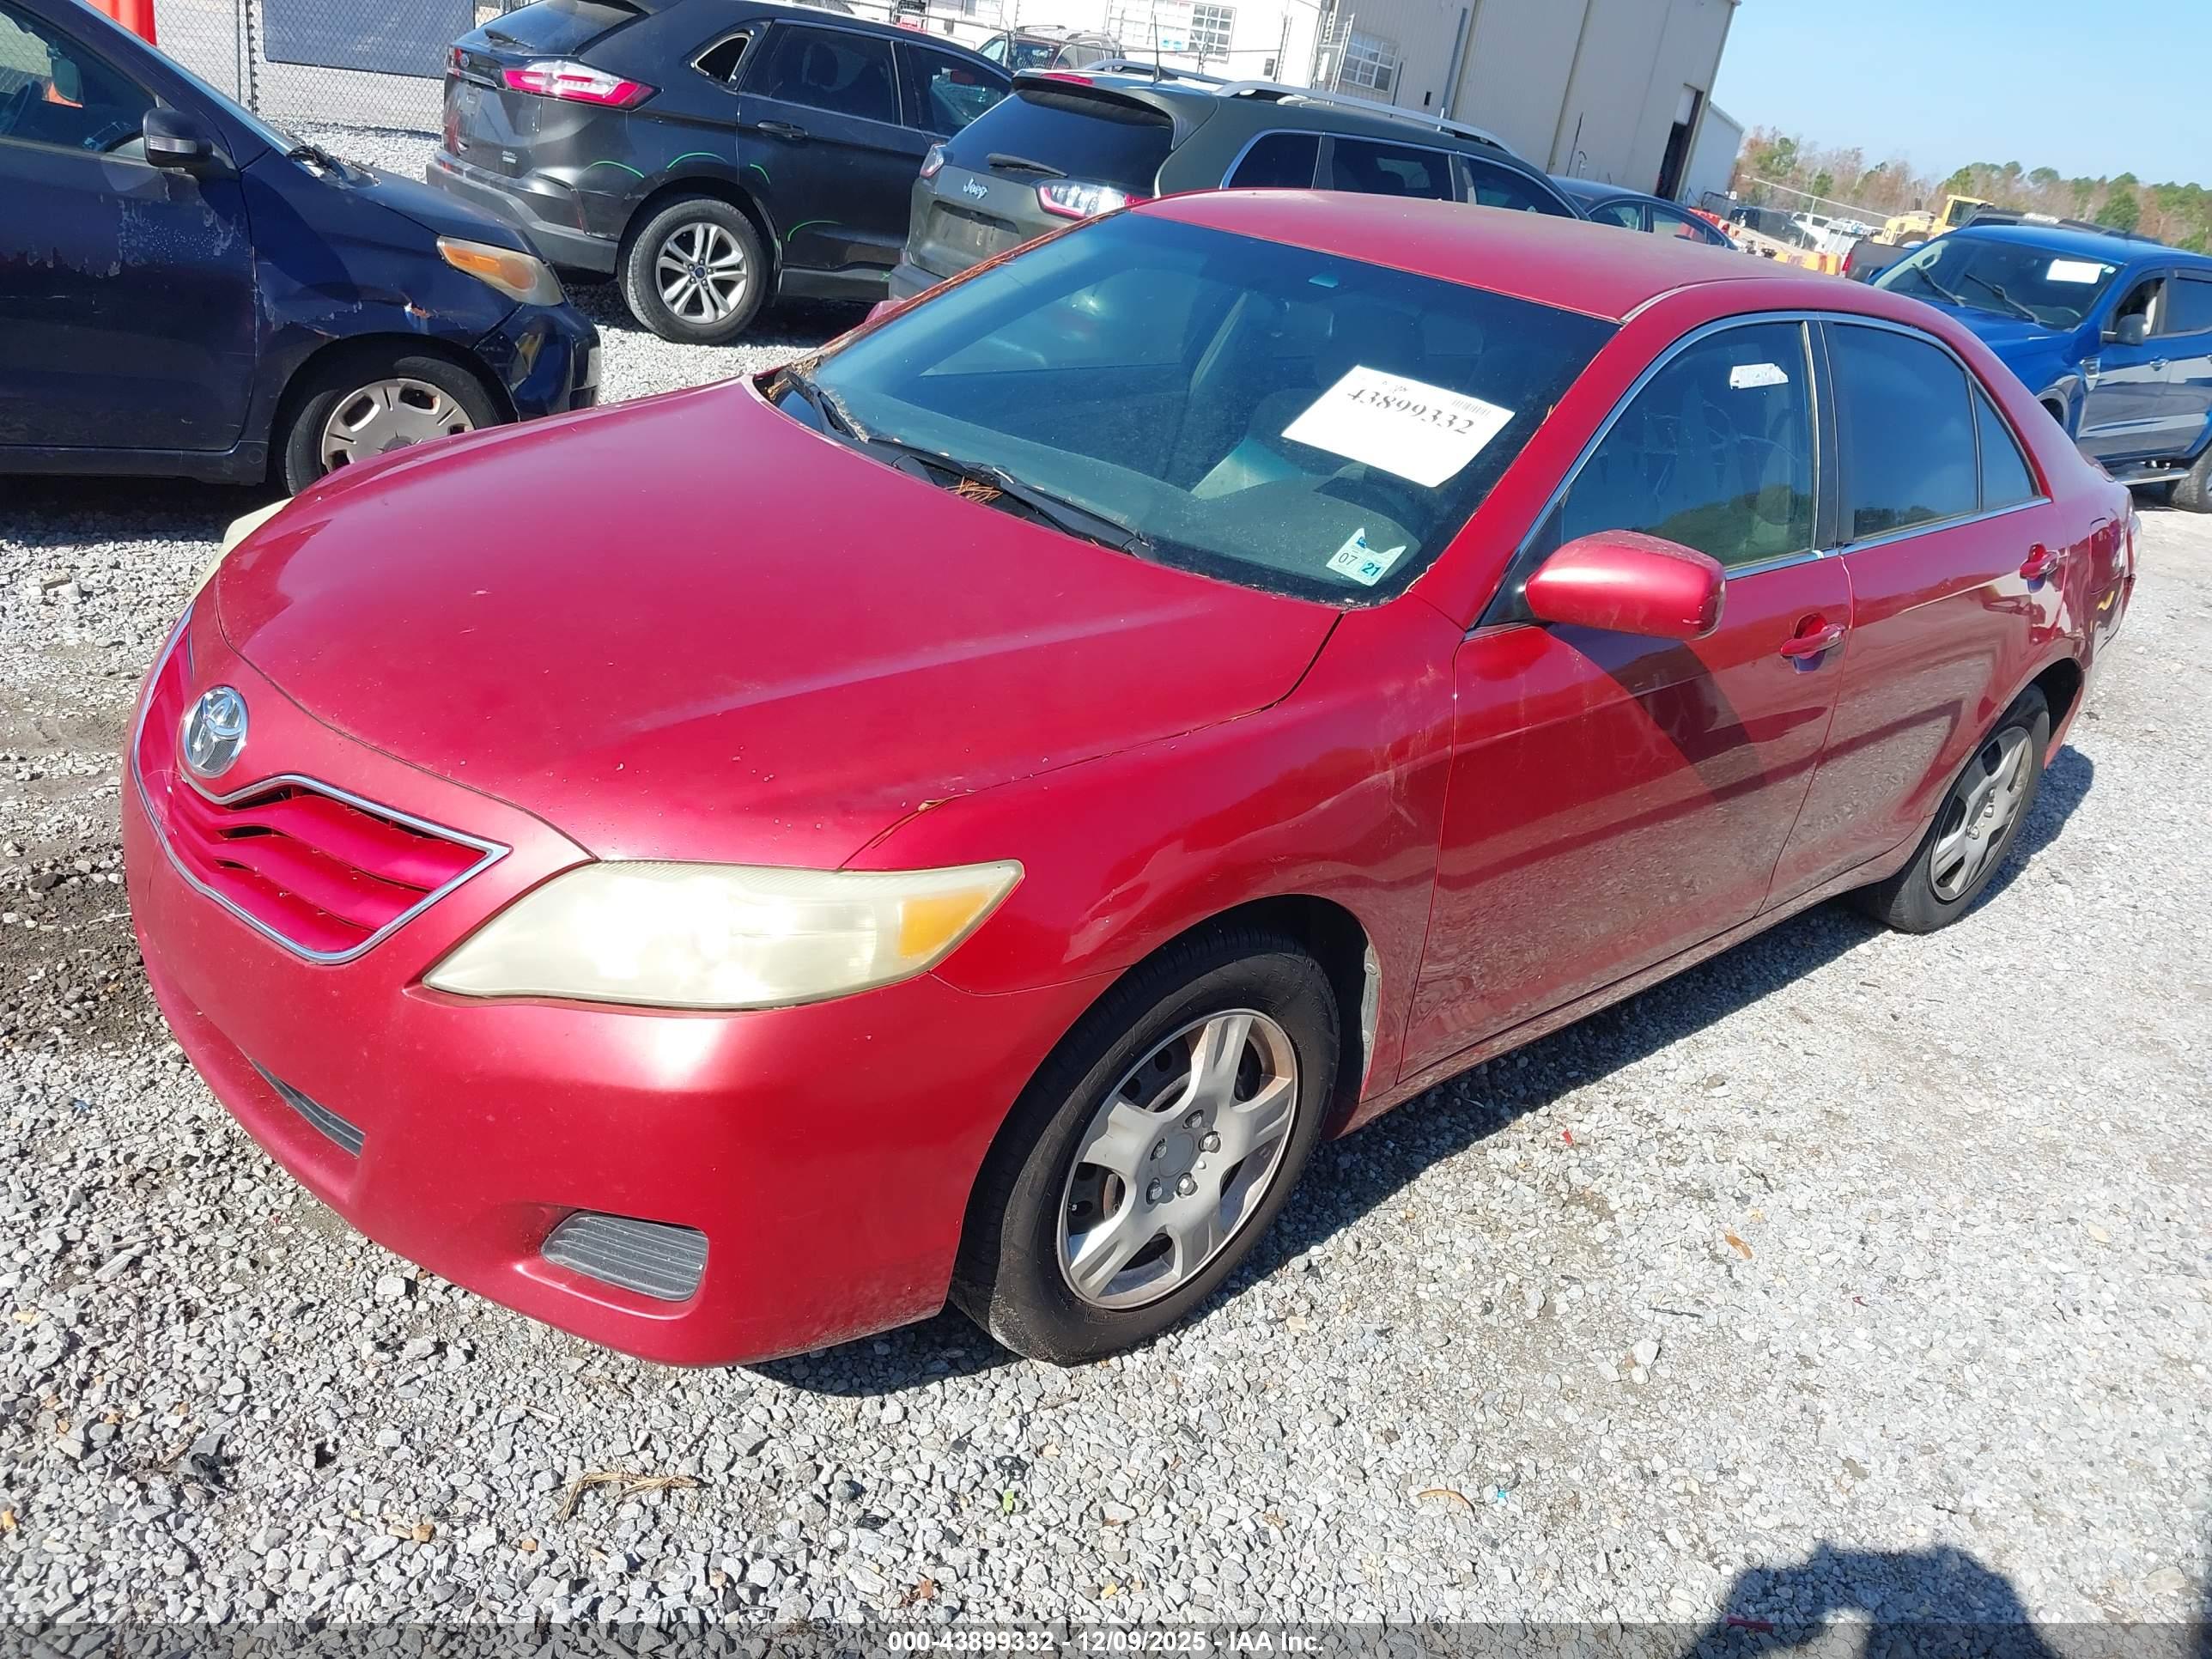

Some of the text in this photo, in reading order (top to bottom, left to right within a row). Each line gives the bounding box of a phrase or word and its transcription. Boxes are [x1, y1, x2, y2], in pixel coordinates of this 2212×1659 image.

[963, 177, 988, 199] Jeep
[1346, 388, 1474, 434] 43899332
[1338, 552, 1358, 566] 07
[1361, 562, 1382, 576] 21
